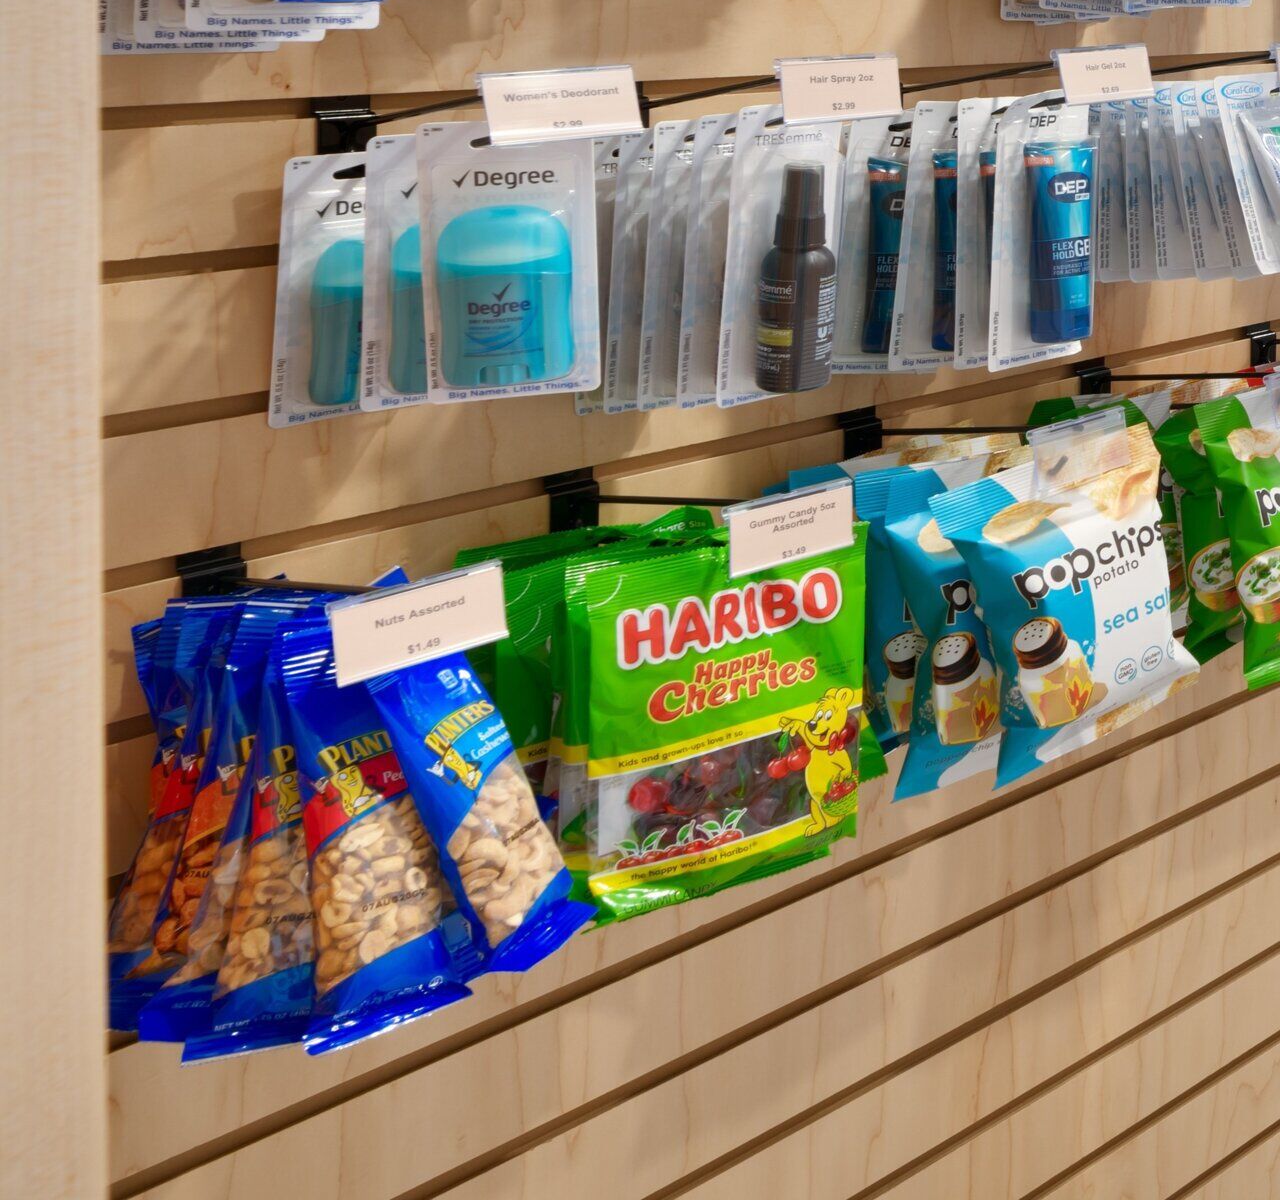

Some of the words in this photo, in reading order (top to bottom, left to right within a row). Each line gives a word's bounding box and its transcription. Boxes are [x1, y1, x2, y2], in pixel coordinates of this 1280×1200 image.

[1085, 63, 1099, 72] Hair
[1101, 62, 1113, 71] Gel
[1114, 61, 1126, 70] 2oz
[810, 74, 829, 85] Hair
[831, 74, 856, 87] Spray
[858, 73, 874, 84] 2oz
[503, 90, 558, 103] Women's
[560, 86, 619, 99] Deodorant
[832, 101, 856, 111] $2.99
[1030, 114, 1057, 128] DEP
[754, 129, 823, 146] TRESemmé
[473, 168, 556, 190] Degree
[1055, 179, 1087, 195] DEP
[1052, 242, 1073, 251] FLEX
[1052, 250, 1074, 260] HOLD
[467, 300, 531, 318] Degree
[749, 513, 787, 530] Gummy
[789, 508, 818, 523] Candy
[820, 501, 836, 515] 5oz
[773, 515, 814, 534] Assorted
[782, 546, 806, 559] $3.49
[1012, 520, 1162, 609] popchips
[1093, 559, 1139, 589] potato
[375, 613, 405, 629] Nuts
[408, 596, 465, 623] Assorted
[618, 568, 842, 669] HARIBO
[407, 638, 441, 654] $1.49
[696, 649, 771, 685] Happy
[648, 656, 817, 723] Cherries
[424, 700, 495, 753] PLANTERS
[618, 759, 639, 769] Kids
[641, 754, 658, 764] and
[662, 744, 705, 761] grown-ups
[708, 737, 724, 747] love
[726, 734, 732, 742] it
[733, 731, 744, 740] so
[624, 892, 677, 915] GUMMI
[680, 881, 718, 903] CANDY
